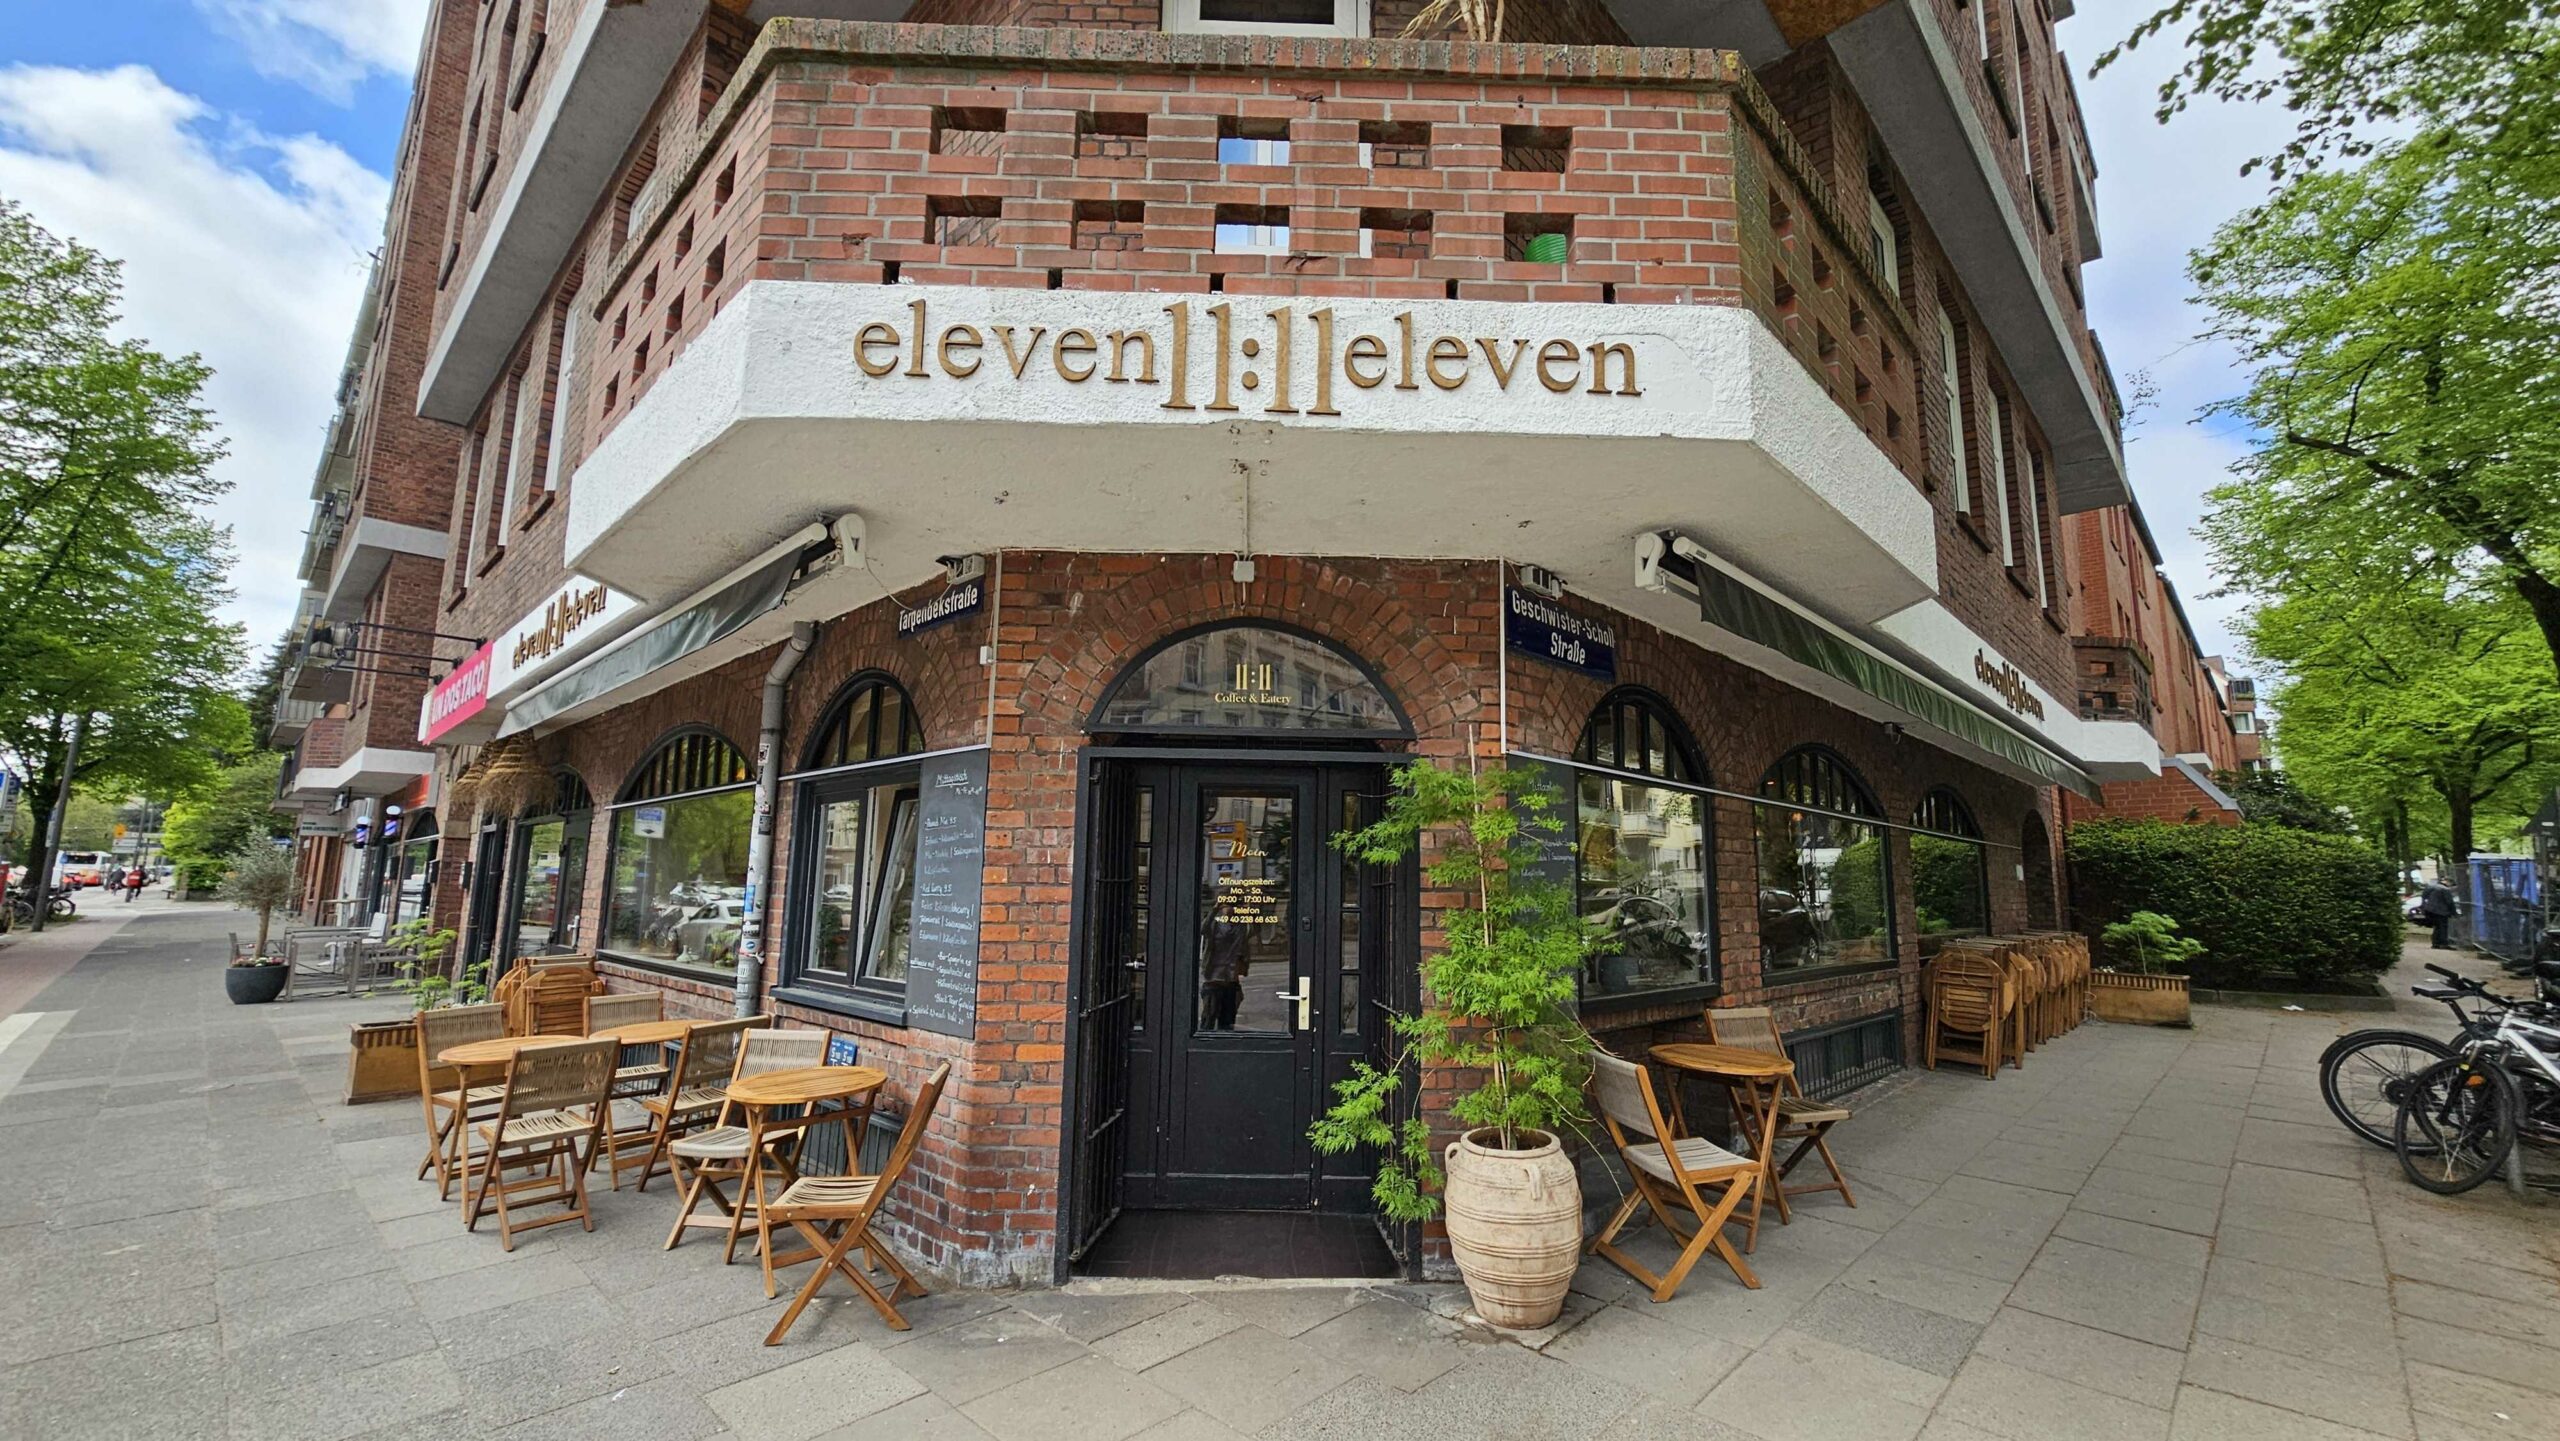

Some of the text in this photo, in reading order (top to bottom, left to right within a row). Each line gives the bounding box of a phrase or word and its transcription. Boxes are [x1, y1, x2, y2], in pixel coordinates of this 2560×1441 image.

[899, 583, 978, 632] Tarpenbekstraße
[1550, 632, 1586, 665] Straße
[1215, 692, 1292, 705] Coffee & Eatery
[1217, 895, 1238, 904] 09:00
[1243, 895, 1262, 904] 17:00
[1262, 895, 1276, 904] Uhr
[1232, 906, 1260, 914] Telefon
[1229, 915, 1240, 923] 40
